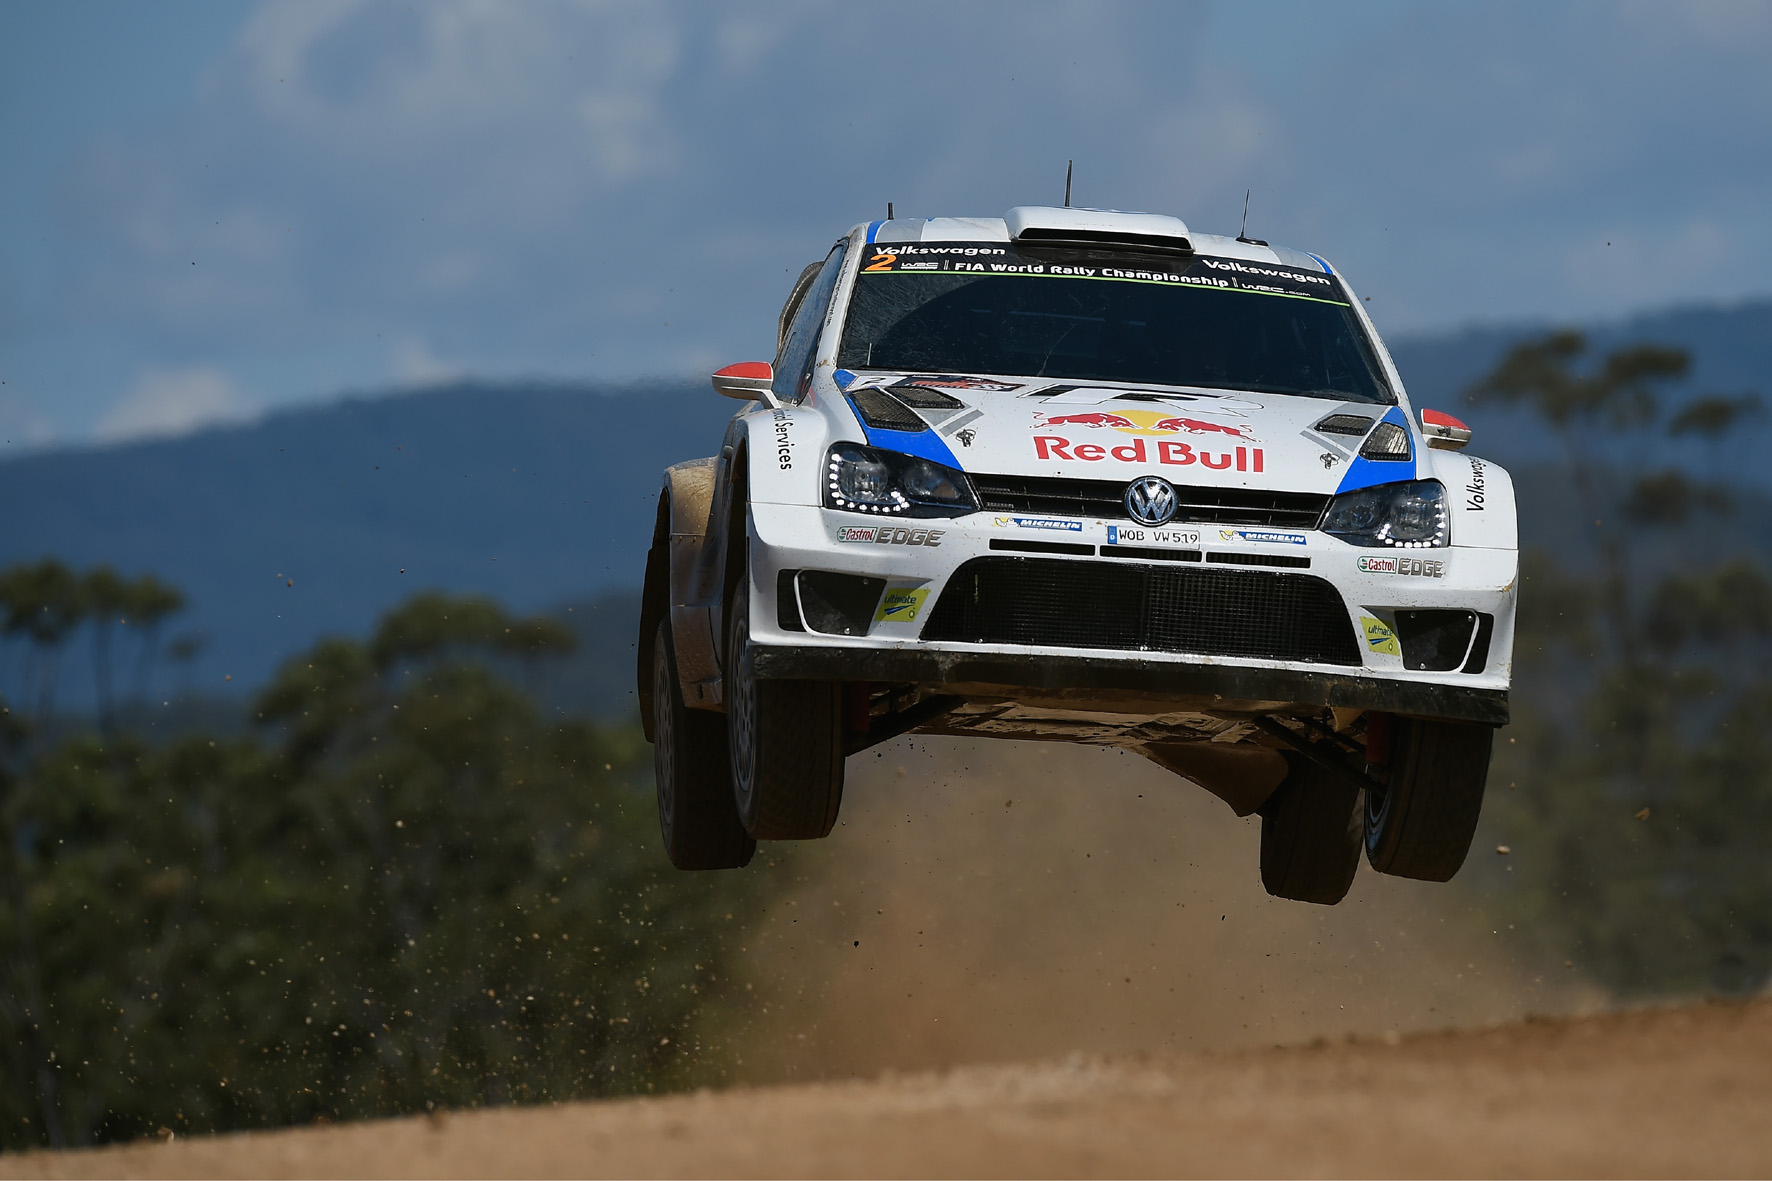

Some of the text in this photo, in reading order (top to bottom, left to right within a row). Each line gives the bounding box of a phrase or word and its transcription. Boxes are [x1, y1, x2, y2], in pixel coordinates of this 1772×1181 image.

[876, 246, 1006, 256] Volkswagen
[864, 254, 897, 271] 2
[954, 262, 1229, 288] FIA World Rally Championship
[1202, 259, 1331, 285] Volkswagen
[775, 422, 795, 470] Services
[1033, 436, 1264, 473] Red Bull
[1020, 519, 1082, 530] MICHELIN
[845, 527, 946, 547] Castrol EDGE
[1119, 530, 1145, 541] WOB
[1245, 532, 1305, 543] MICHELIN
[1368, 558, 1444, 578] Castrol EDGE
[885, 594, 917, 605] ultimate
